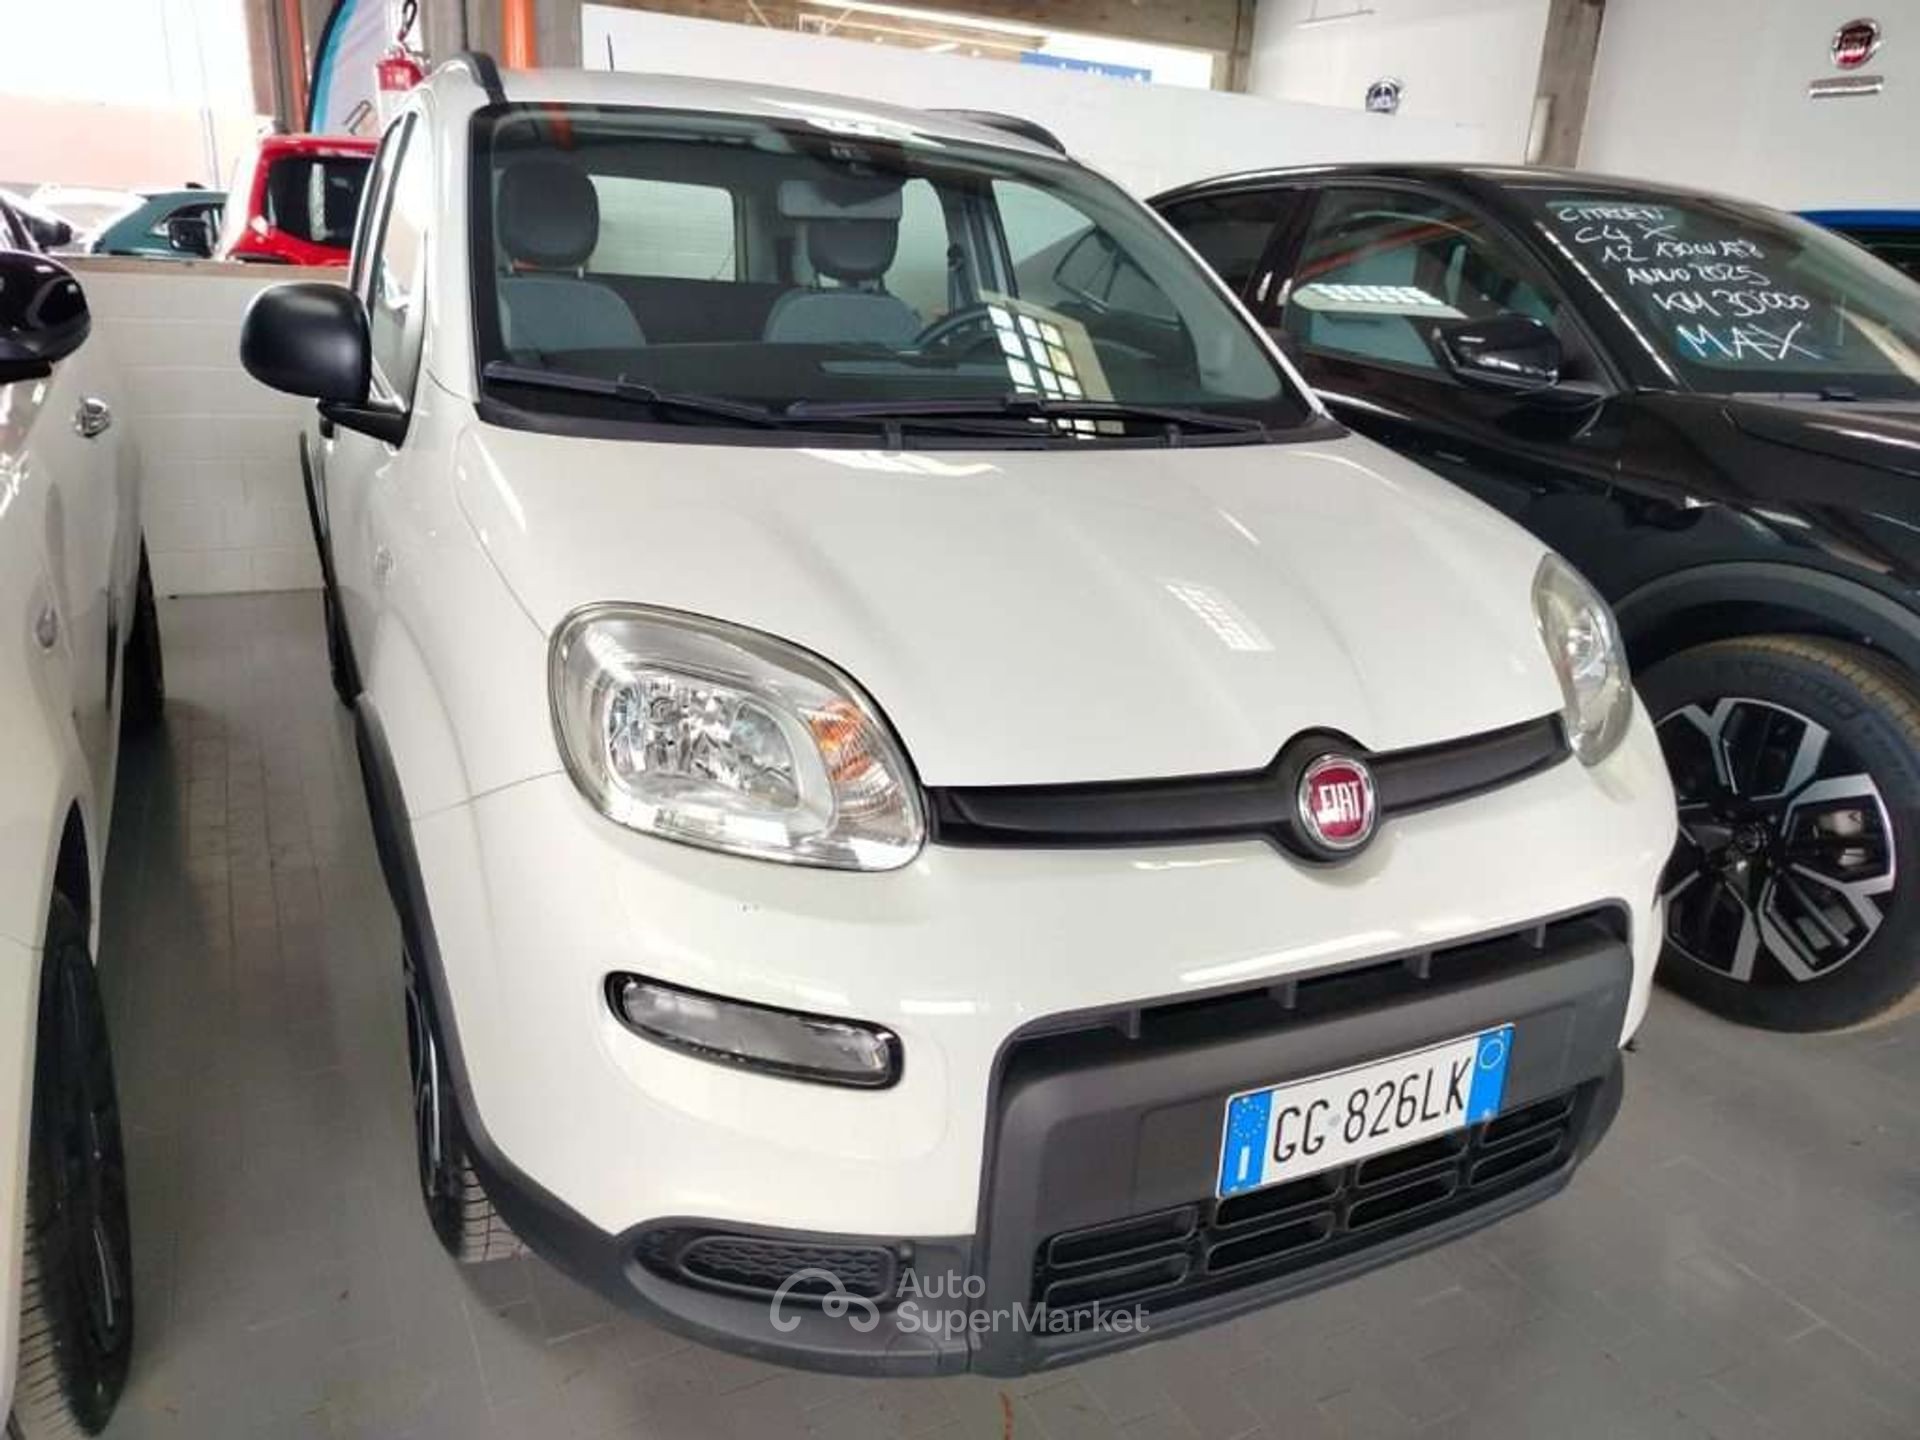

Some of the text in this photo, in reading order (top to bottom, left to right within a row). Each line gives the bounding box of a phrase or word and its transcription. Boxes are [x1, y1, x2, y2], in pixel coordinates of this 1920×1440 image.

[1575, 223, 1679, 244] C4 X
[1652, 291, 1721, 317] KM
[1676, 321, 1824, 361] MAX
[1316, 780, 1361, 824] FIAT
[1273, 1099, 1329, 1163] GG
[1343, 1056, 1472, 1144] 826LK
